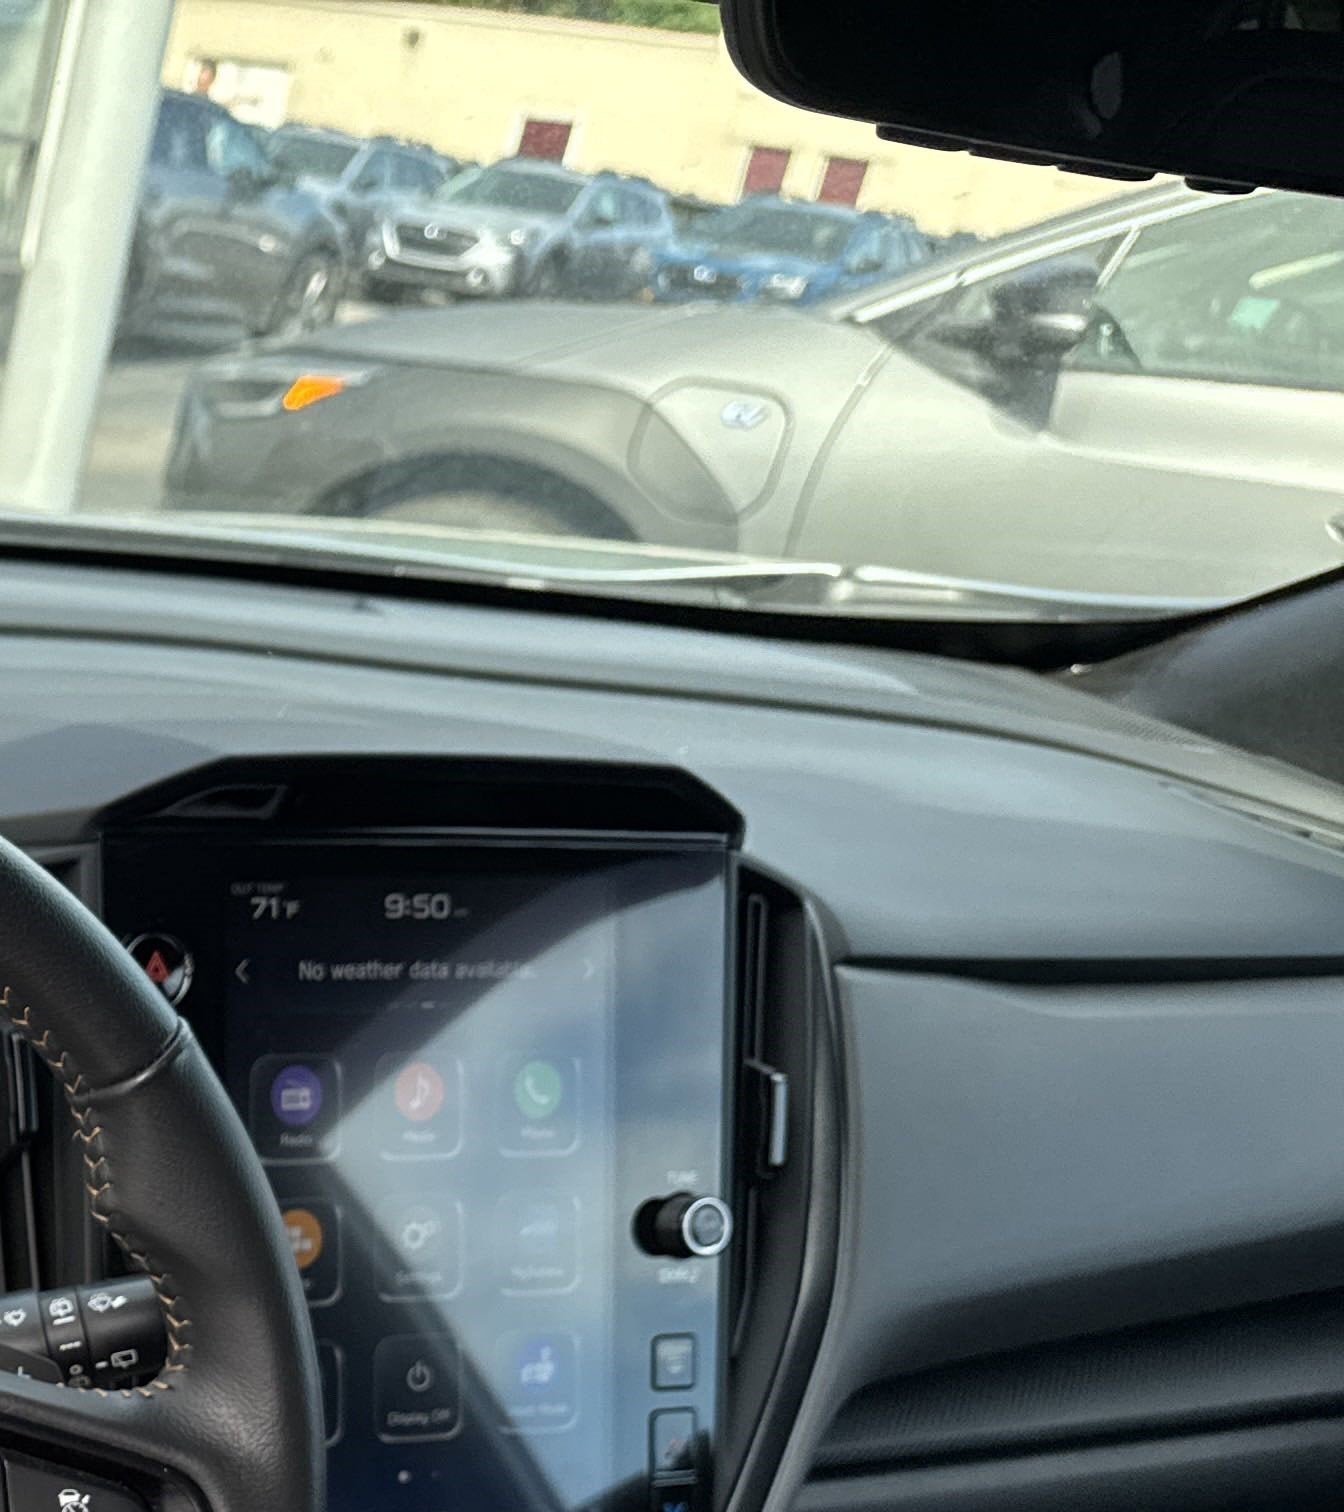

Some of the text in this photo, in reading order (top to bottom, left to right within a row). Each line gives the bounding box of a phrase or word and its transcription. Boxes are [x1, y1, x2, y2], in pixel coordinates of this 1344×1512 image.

[384, 893, 451, 920] 9:50
[297, 960, 325, 982] No
[330, 960, 404, 982] weather
[410, 960, 449, 981] data
